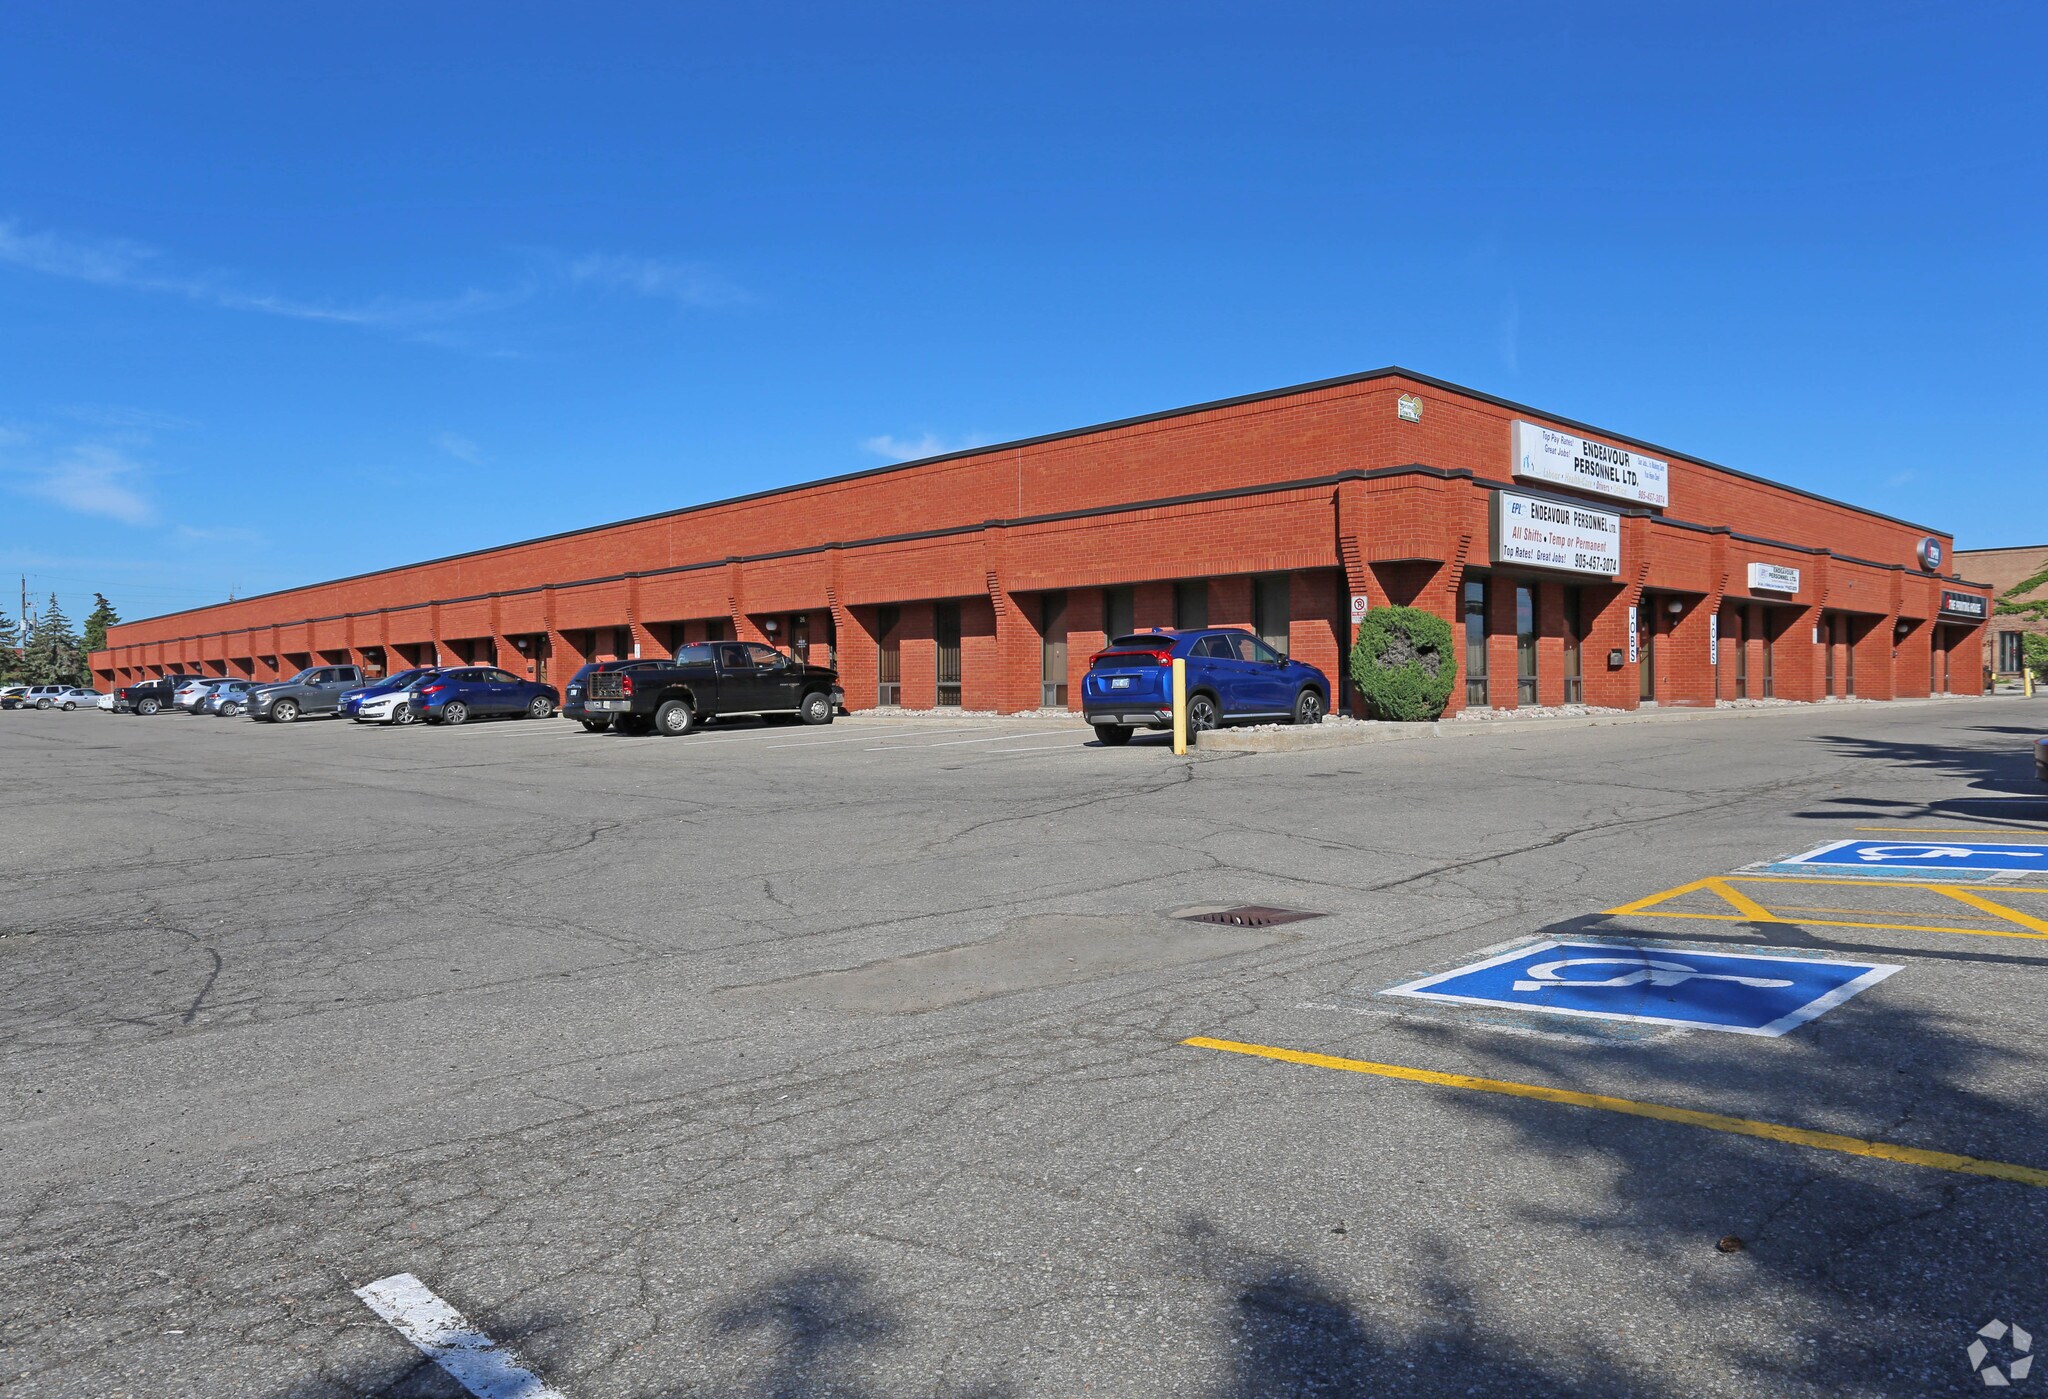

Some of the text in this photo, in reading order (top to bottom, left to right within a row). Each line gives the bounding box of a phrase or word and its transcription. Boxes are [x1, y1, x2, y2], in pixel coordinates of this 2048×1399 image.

[1542, 430, 1550, 442] Top
[1551, 433, 1560, 445] Pay
[1544, 443, 1571, 458] Great Jobs!
[1582, 440, 1630, 467] ENDEAVOUR
[1574, 456, 1620, 483] PERSONNEL
[1596, 480, 1610, 492] Drivers
[1638, 489, 1665, 503] 905-457-3074
[1511, 502, 1522, 514] EPL
[1531, 502, 1570, 525] ENDEAVOUR
[1573, 511, 1608, 532] PERSONNEL
[1512, 525, 1607, 552] All Shifts Temp or Permanent
[1503, 544, 1617, 572] Top Rates! Great Jobs! 905-457-3074
